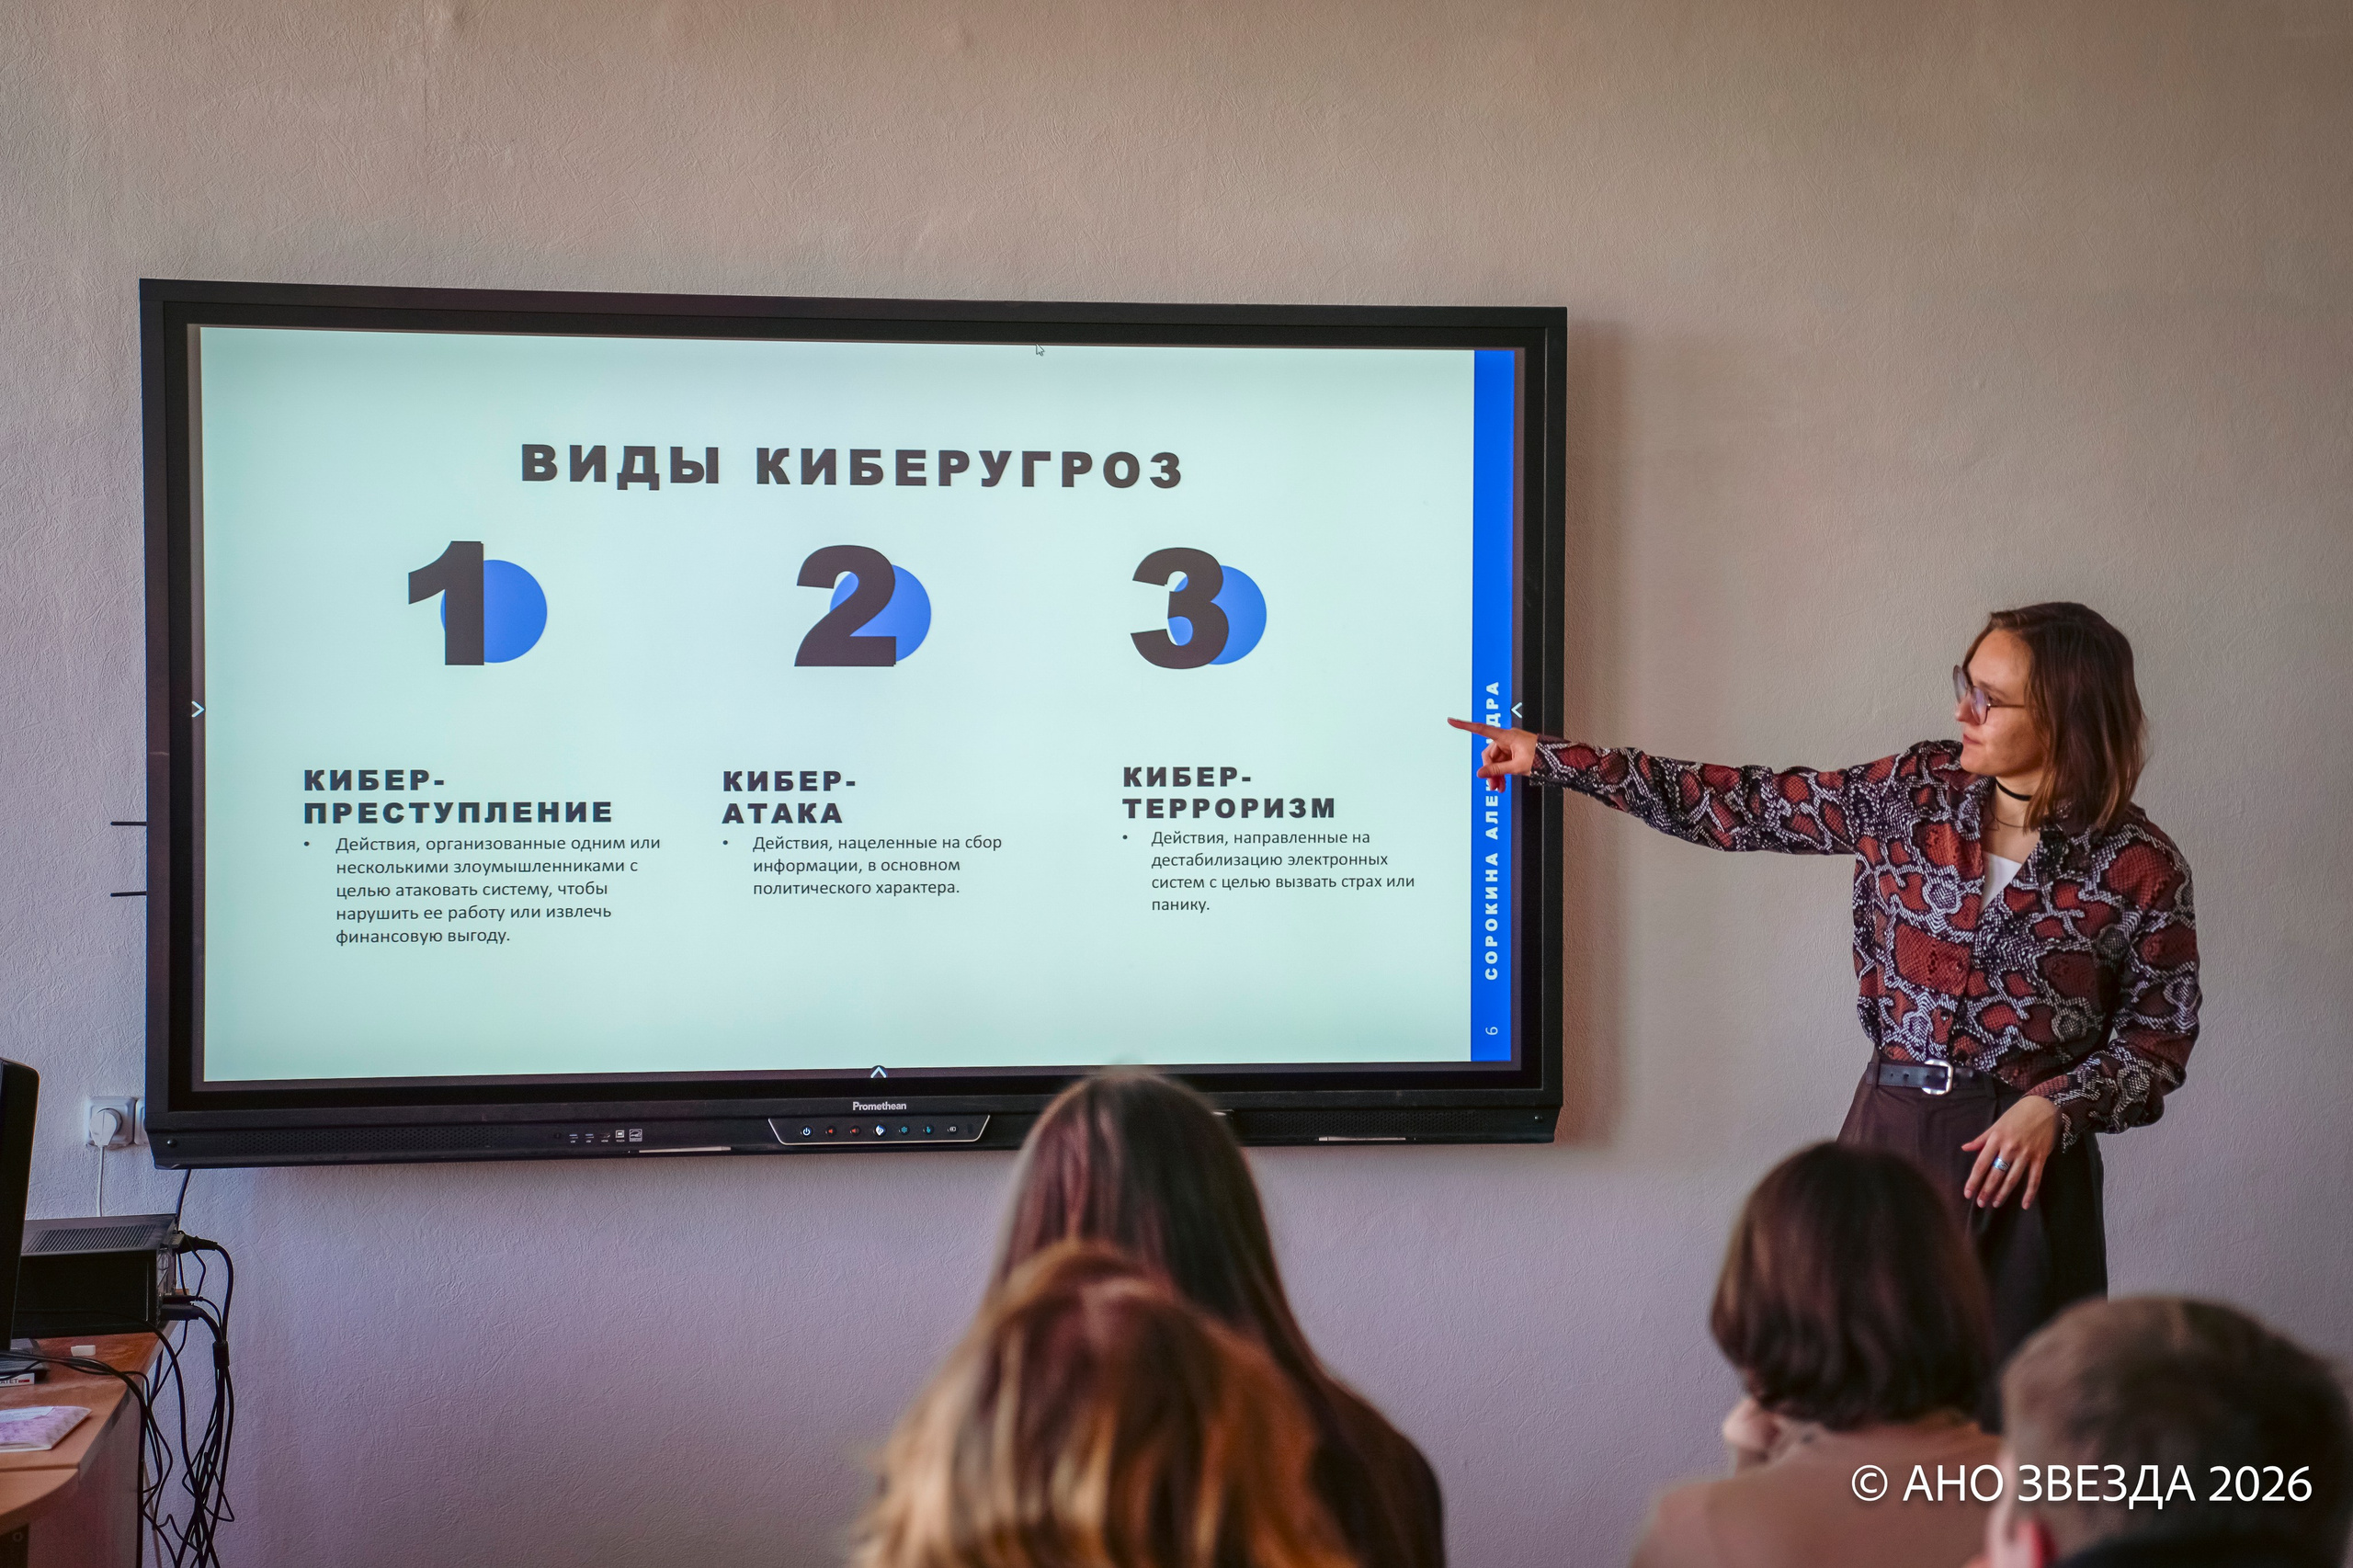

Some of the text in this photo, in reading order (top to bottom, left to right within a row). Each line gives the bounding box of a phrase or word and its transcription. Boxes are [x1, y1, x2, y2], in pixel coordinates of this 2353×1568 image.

[522, 444, 1182, 491] ВИДЫ КИБЕРУГРОЗ
[408, 540, 484, 666] 1
[794, 544, 897, 667] 2
[1131, 547, 1230, 670] 3
[304, 769, 445, 791] КИБЕР-
[723, 770, 856, 792] КИБЕР-
[1123, 767, 1251, 788] КИБЕР-
[304, 801, 613, 824] ПРЕСТУПЛЕНИЕ
[722, 802, 843, 824] АТАКА
[1122, 797, 1335, 819] ТЕРРОРИЗМ
[1151, 830, 1370, 847] Действия, направленные на
[1484, 681, 1501, 981] СОРОКИНА АЛЕДРА
[335, 836, 660, 855] Действия, организованные одним или
[752, 835, 1002, 853] Действия, нацеленные на сбор
[336, 861, 639, 877] несколькими злоумышленниками с
[754, 858, 961, 876] информации, в основном
[1151, 852, 1388, 869] дестабилизацию электронных
[336, 881, 608, 901] целью атаковать систему, чтобы
[753, 883, 960, 897] политического характера.
[1152, 877, 1415, 892] систем с целью вызвать страх или
[336, 904, 612, 924] нарушить ее работу или извлечь
[1152, 900, 1210, 914] панику.
[335, 929, 510, 947] финансовую выгоду.
[1485, 1026, 1498, 1036] 6
[853, 1102, 907, 1110] Promethean
